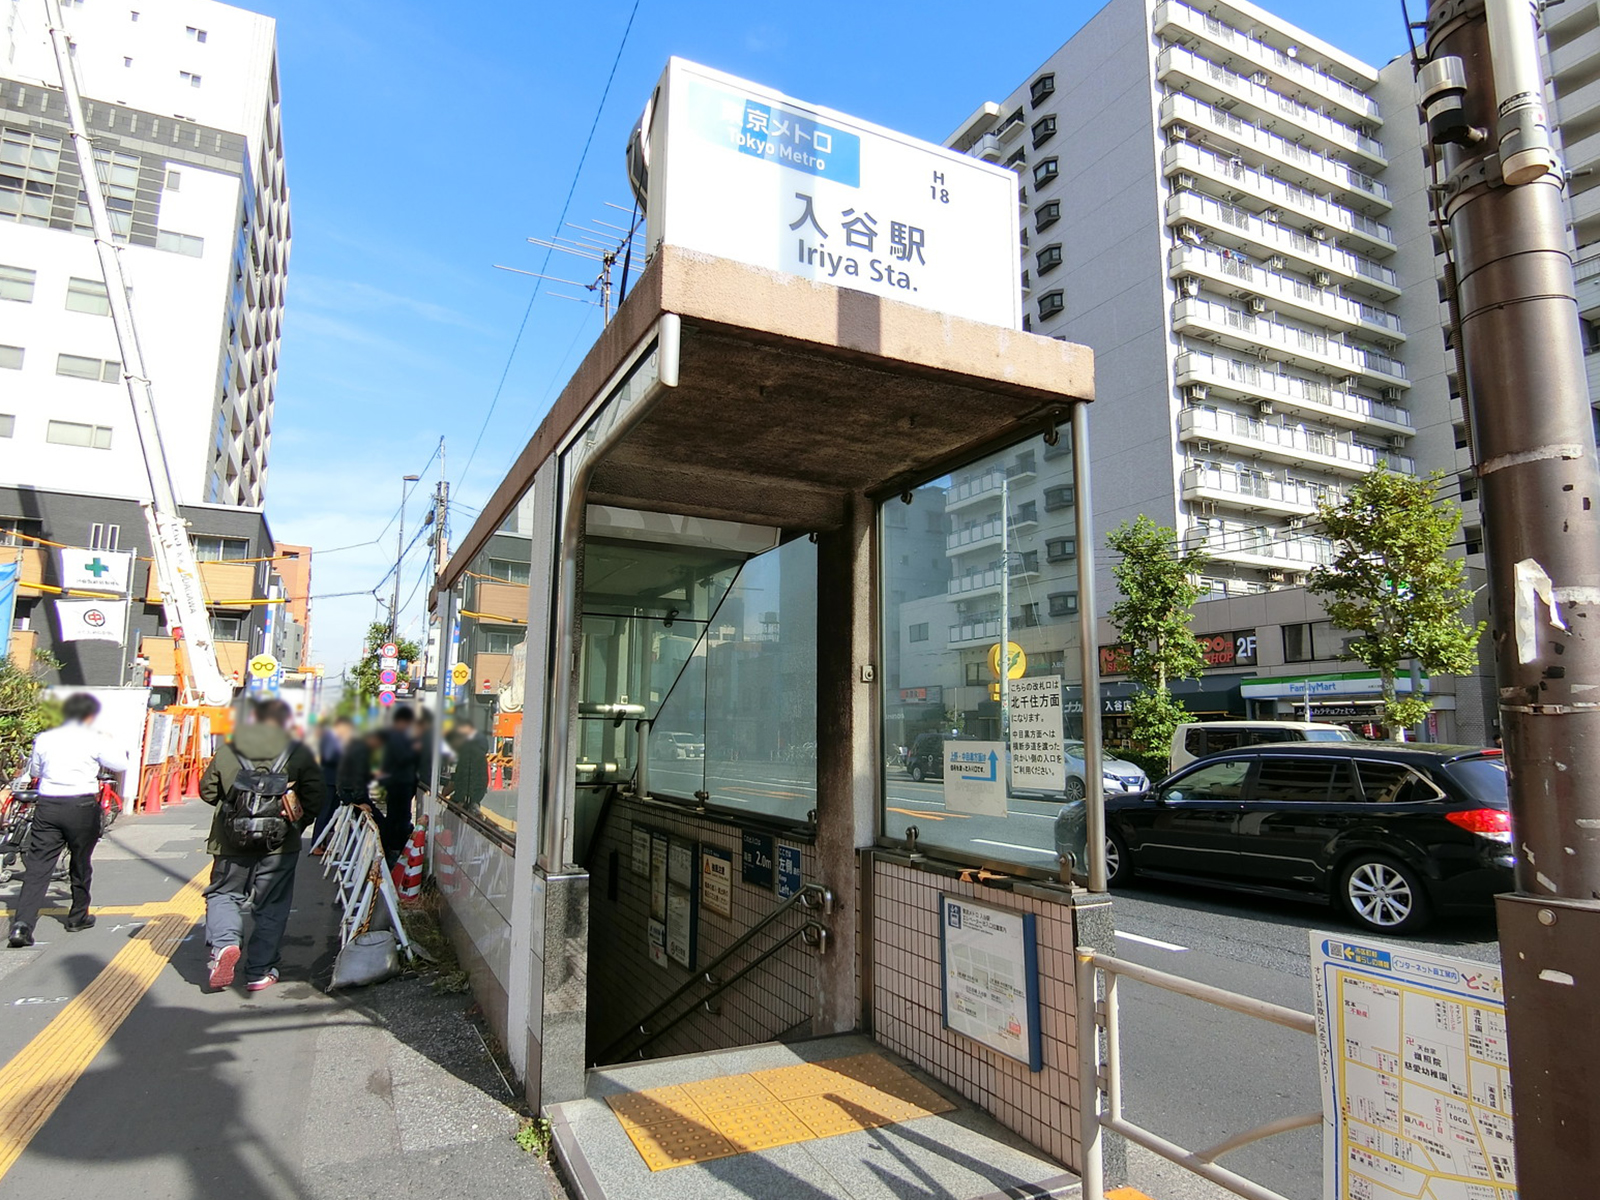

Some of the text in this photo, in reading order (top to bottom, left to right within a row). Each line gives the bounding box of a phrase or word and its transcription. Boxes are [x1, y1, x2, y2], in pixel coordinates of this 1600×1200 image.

[780, 144, 825, 171] Metro
[932, 170, 945, 186] H
[930, 185, 950, 204] 18
[788, 191, 927, 266] 入谷駅
[798, 238, 919, 292] Iriya Sta.
[1011, 680, 1059, 692] こちらの改札口は
[1290, 682, 1336, 693] FamlyMart
[1011, 694, 1060, 709] 北千住方面
[1011, 713, 1044, 723] になります。
[1012, 730, 1055, 739] 中目黒方面へは
[1013, 742, 1060, 752] 横断歩道を渡った
[1013, 754, 1062, 764] 向かい側の入口を
[1014, 766, 1055, 776] ご利用ください。
[755, 850, 772, 870] 2.0m
